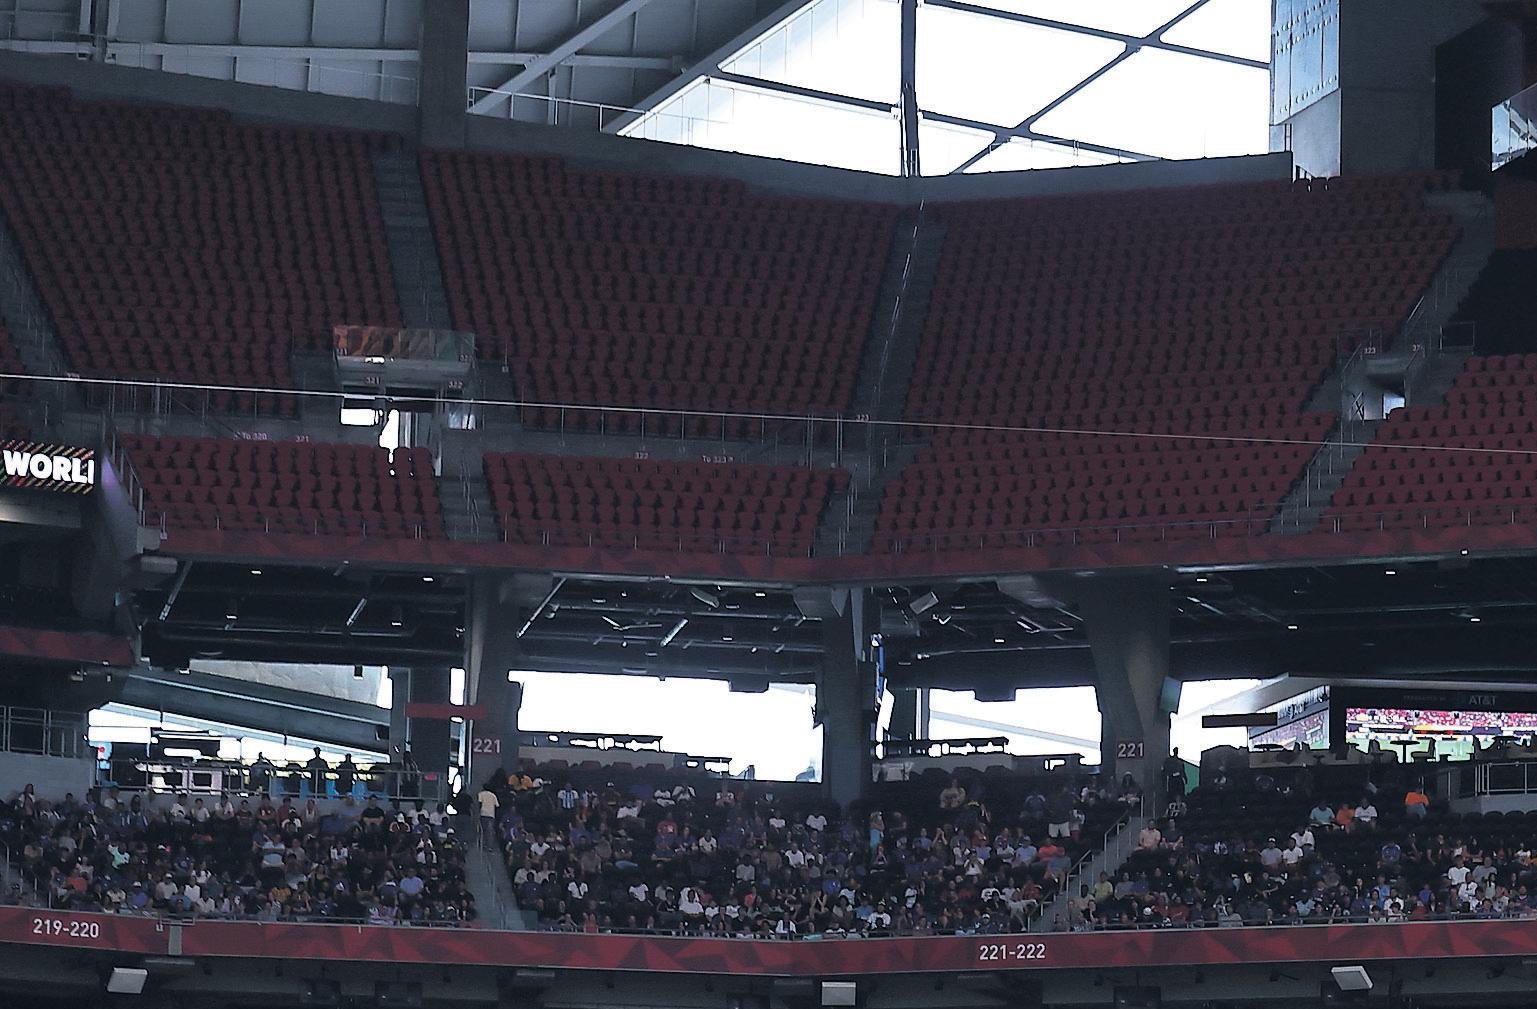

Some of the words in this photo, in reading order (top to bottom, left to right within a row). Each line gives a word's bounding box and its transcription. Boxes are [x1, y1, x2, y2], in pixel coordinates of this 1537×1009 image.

[473, 739, 502, 754] 221
[1118, 742, 1144, 757] 221
[32, 918, 100, 939] 219-220
[979, 943, 1046, 960] 221-222
